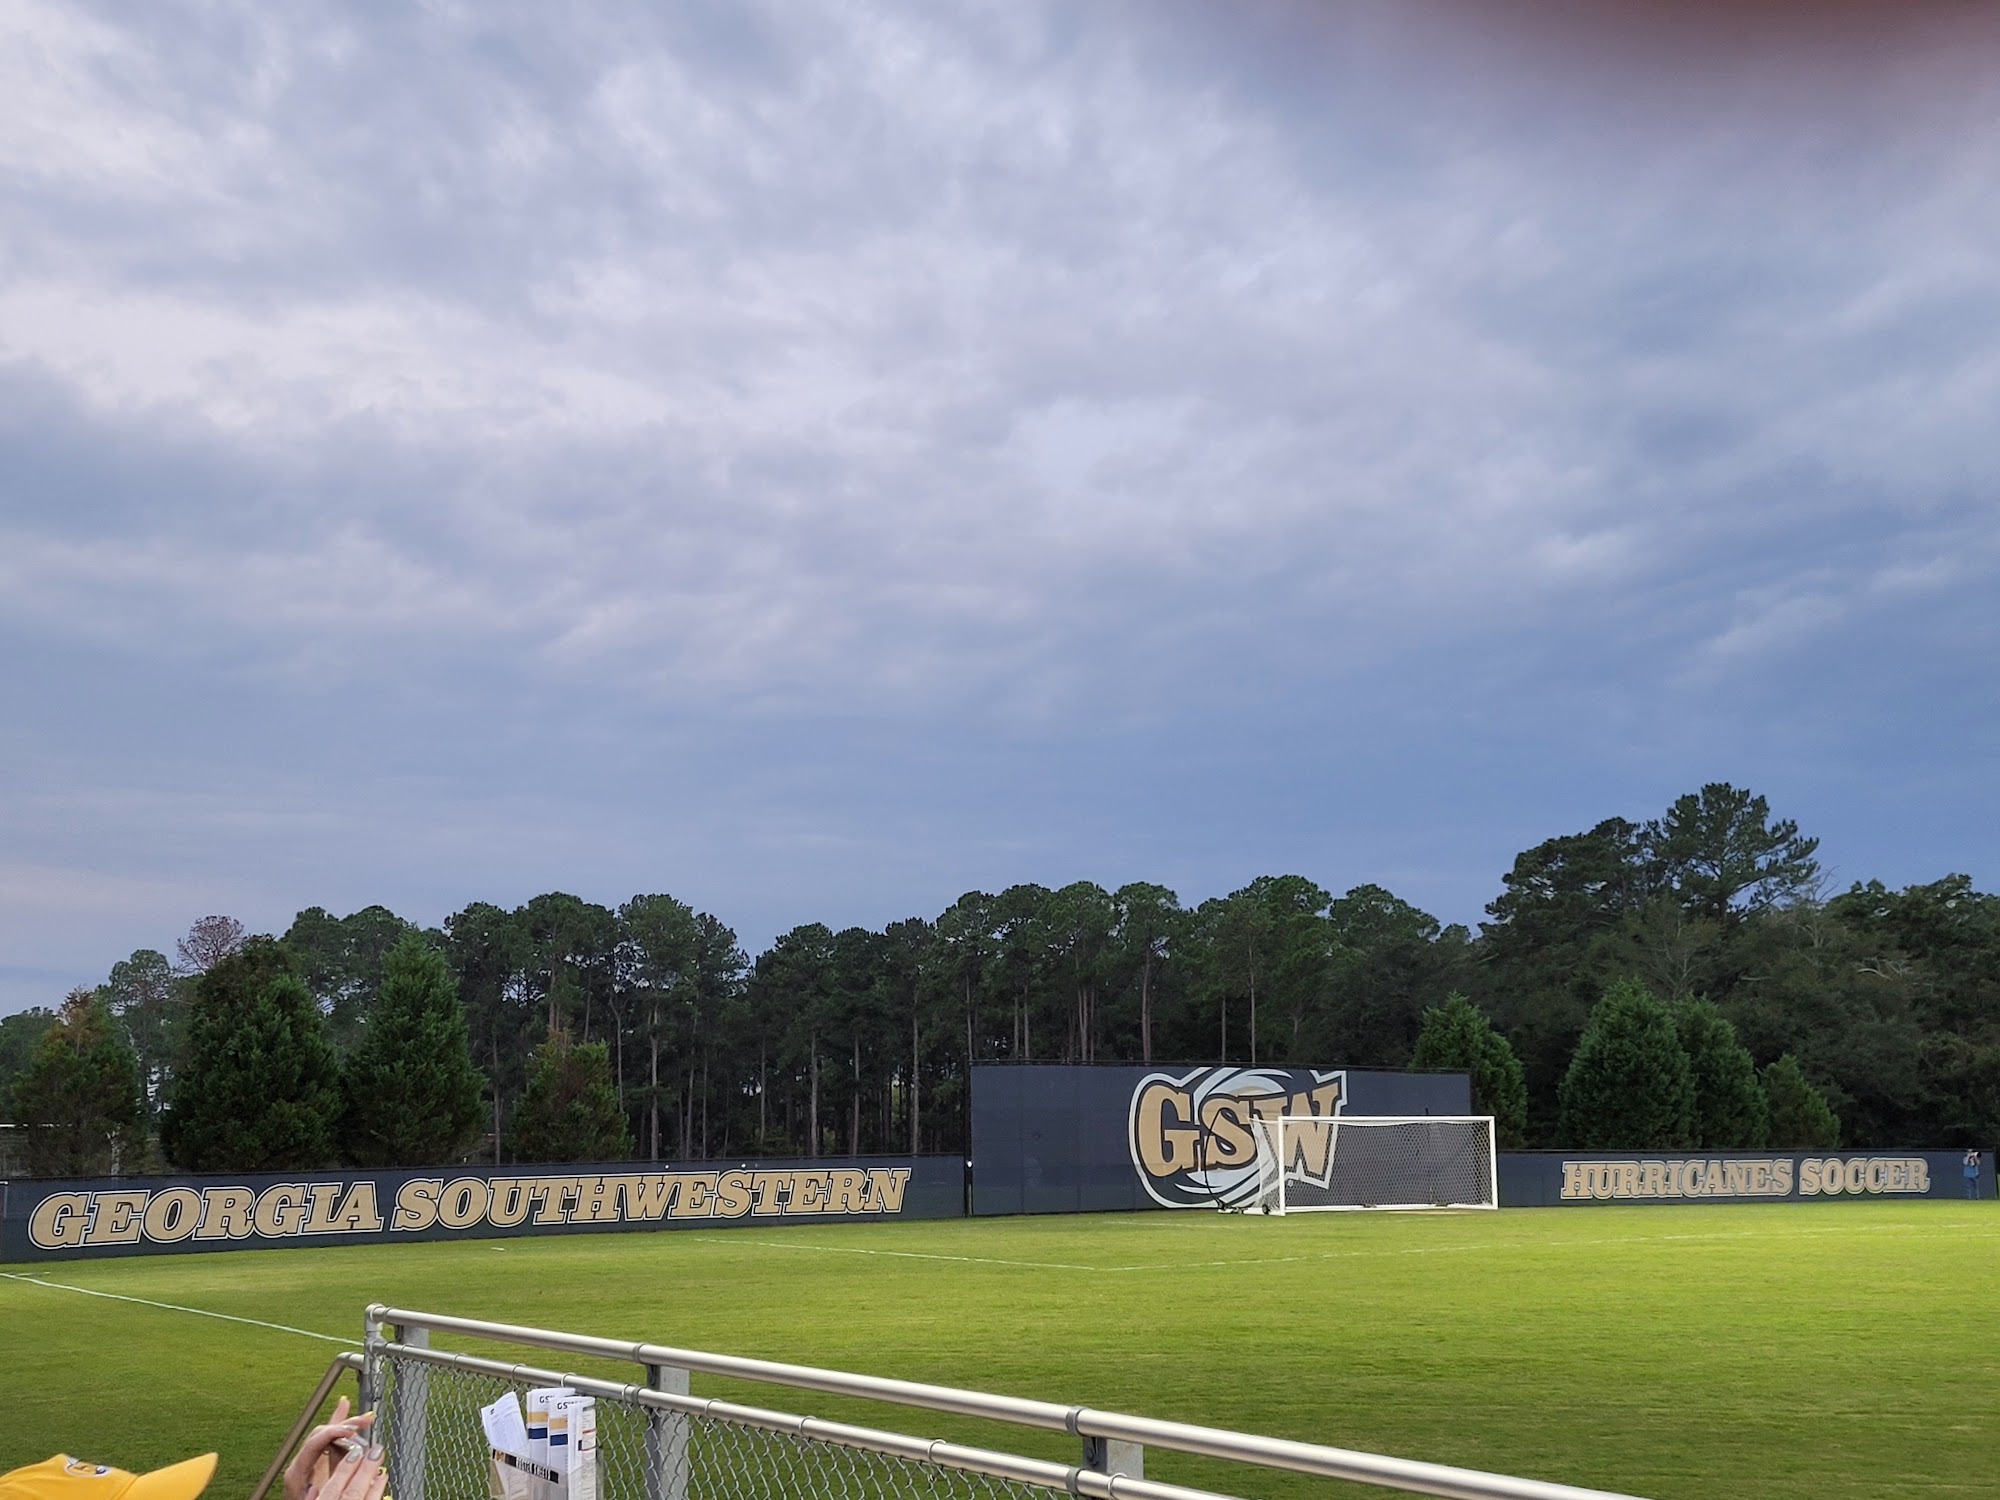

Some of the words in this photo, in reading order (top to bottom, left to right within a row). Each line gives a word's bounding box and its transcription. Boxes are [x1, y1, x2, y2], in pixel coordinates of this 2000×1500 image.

[1133, 1075, 1344, 1190] GSW
[28, 1181, 383, 1250] GEORGIA
[390, 1168, 911, 1231] SOUTHWESTERN
[1561, 1159, 1793, 1199] HURRICANES
[1799, 1157, 1930, 1195] SOCCER
